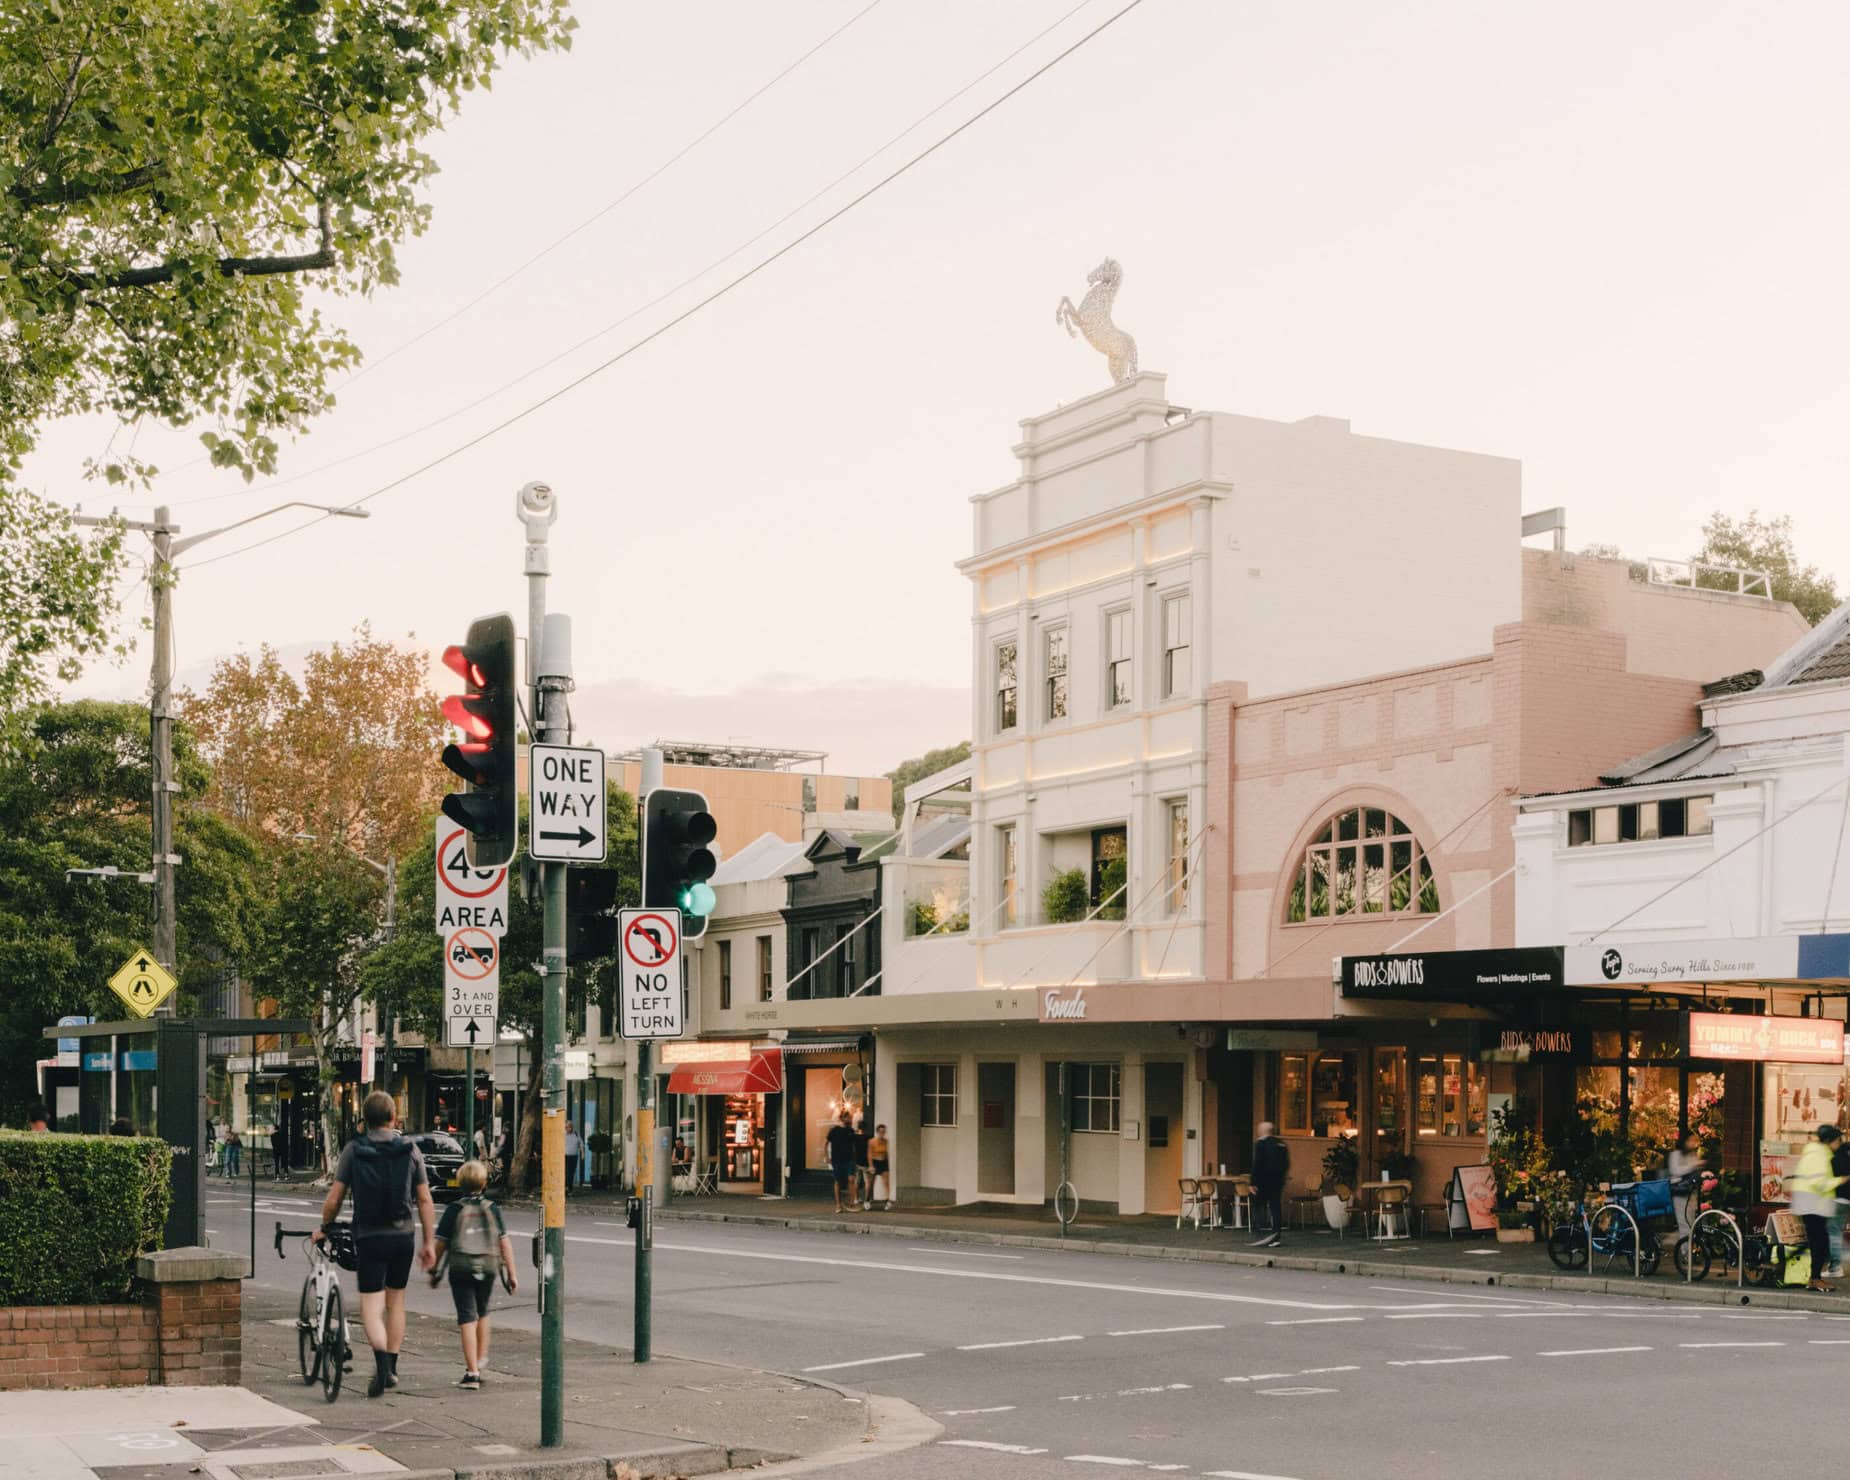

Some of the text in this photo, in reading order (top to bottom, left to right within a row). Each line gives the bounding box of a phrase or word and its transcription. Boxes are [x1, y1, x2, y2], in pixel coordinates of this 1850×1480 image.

[543, 757, 592, 783] ONE
[540, 792, 596, 818] WAY
[440, 907, 505, 928] AREA
[1354, 959, 1424, 987] BUDS BOWERS
[1477, 972, 1551, 983] Flowers Weddings Events
[1628, 962, 1658, 979] Serving
[1661, 961, 1685, 978] Surry
[1689, 959, 1711, 972] Hills
[1713, 959, 1736, 972] Since
[635, 974, 668, 992] NO
[472, 992, 494, 1001] AND
[632, 998, 671, 1010] LEFT
[1045, 987, 1087, 1019] Fonda
[453, 1004, 493, 1015] OVER
[631, 1016, 674, 1029] TURN
[1501, 1031, 1572, 1053] BUDS BOWERS
[1696, 1025, 1818, 1048] YUMMY DUCK
